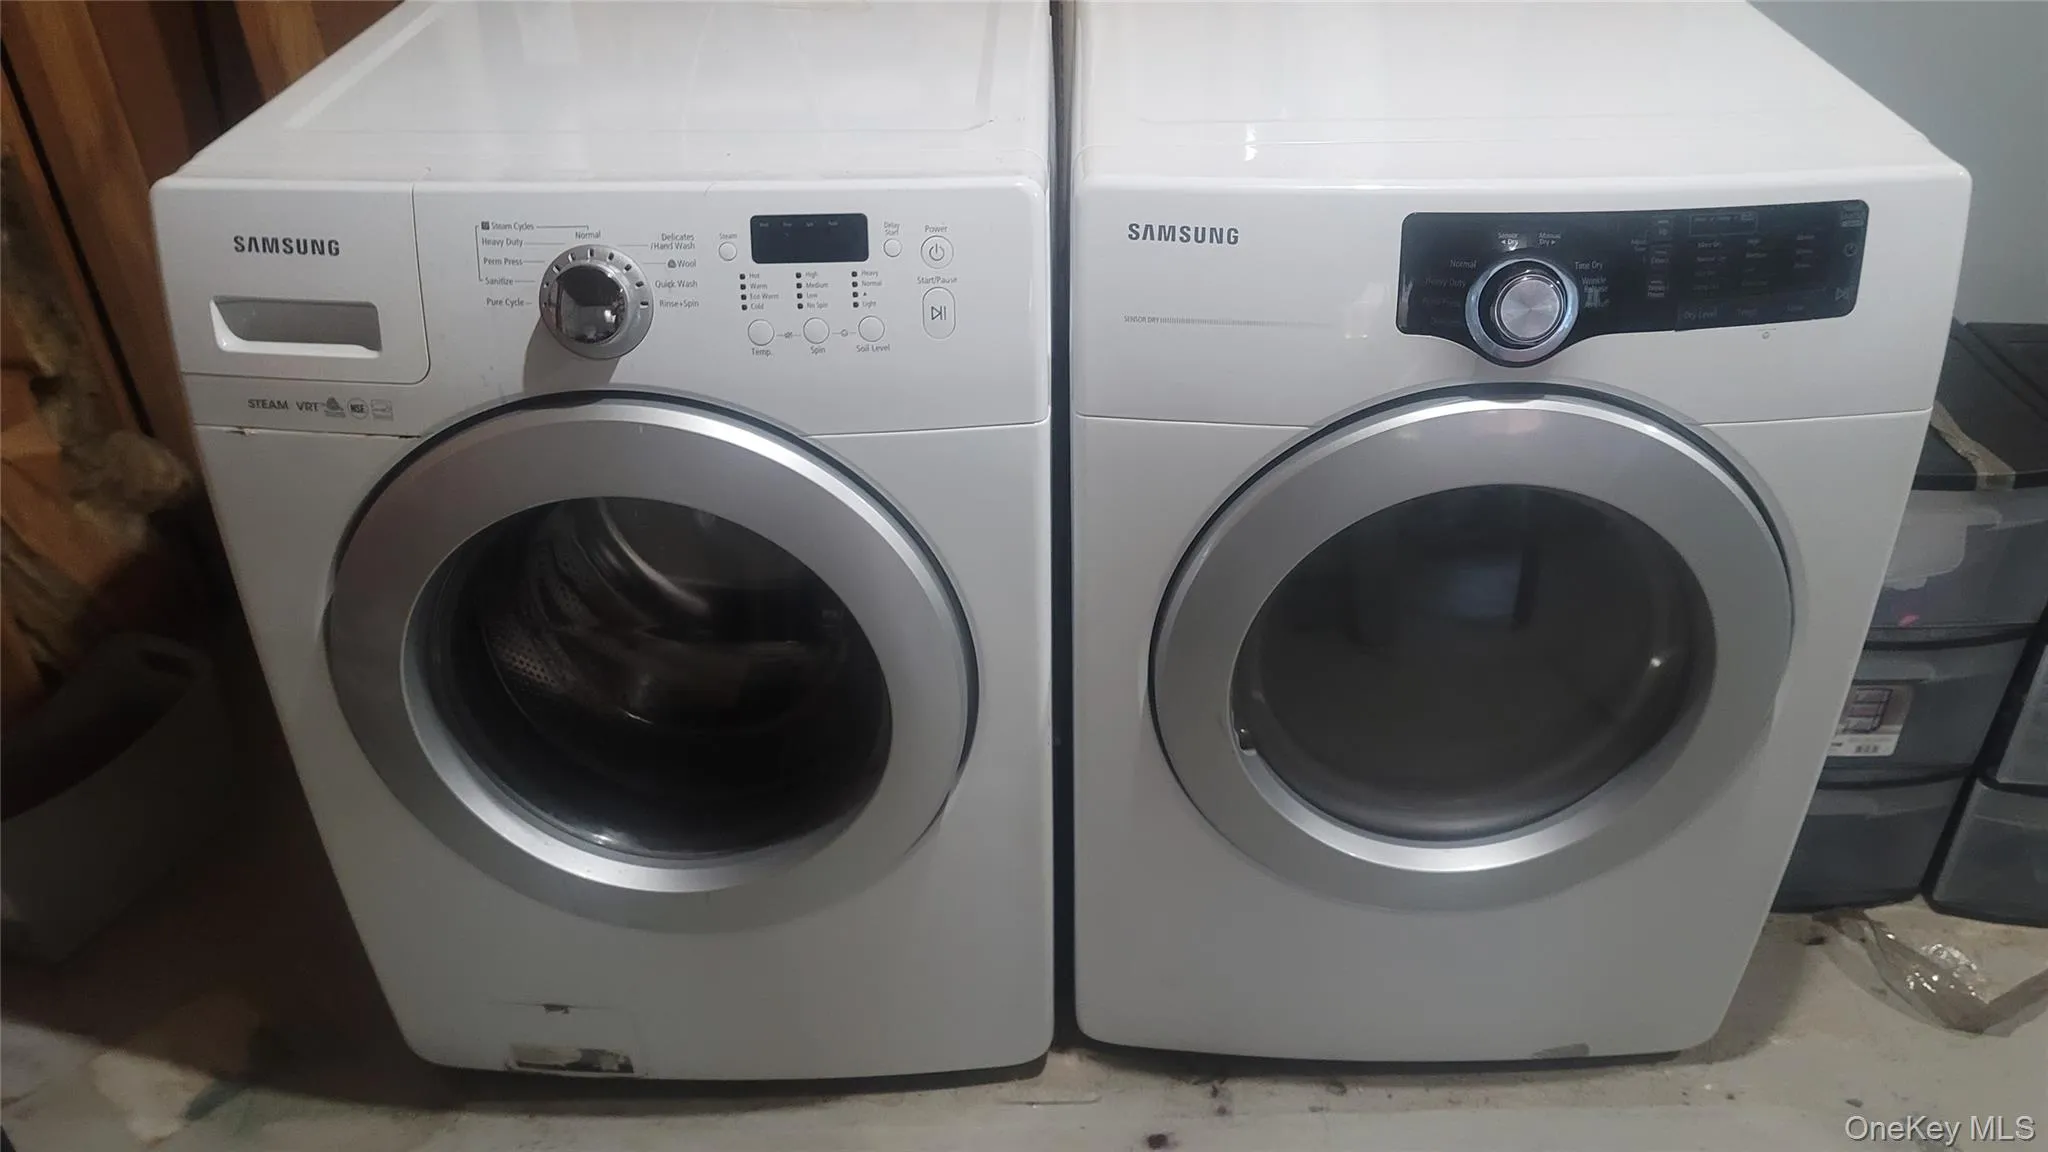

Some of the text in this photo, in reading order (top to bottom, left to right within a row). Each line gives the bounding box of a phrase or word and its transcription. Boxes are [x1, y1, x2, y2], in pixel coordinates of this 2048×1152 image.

[490, 222, 535, 232] Steam Cycles
[924, 224, 948, 233] Power
[575, 230, 601, 240] Normal
[661, 232, 695, 241] Delicates
[719, 232, 738, 240] Steam
[1127, 222, 1240, 246] SAMSUNG
[233, 235, 341, 257] SAMSUNG
[481, 237, 524, 247] Heavy Duty
[674, 242, 696, 250] Wash
[483, 257, 523, 265] Perm Press
[677, 258, 697, 268] Wool
[1450, 259, 1477, 269] Normal
[1591, 261, 1603, 270] Dry
[485, 277, 514, 285] Sanitize
[655, 279, 698, 288] Quick Wash
[917, 276, 958, 285] Start/Pause
[486, 297, 525, 308] Pure Cycle
[810, 346, 826, 355] Spin
[856, 344, 890, 352] Soil Level
[247, 398, 289, 410] STEAM
[295, 401, 319, 412] VRT
